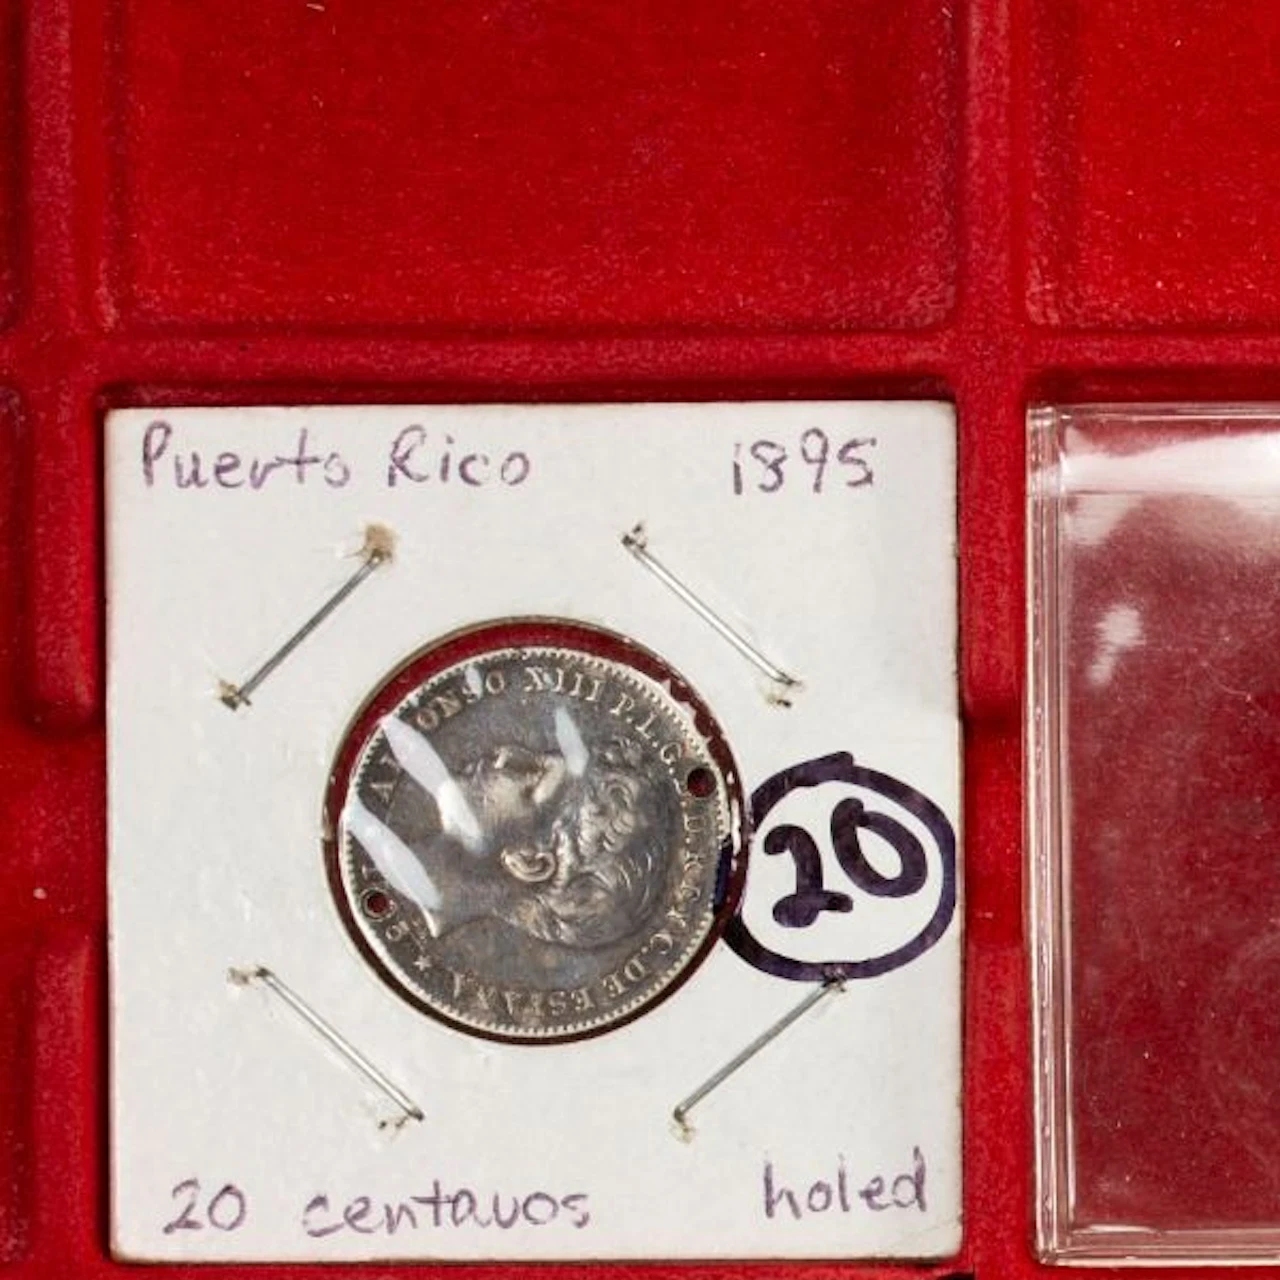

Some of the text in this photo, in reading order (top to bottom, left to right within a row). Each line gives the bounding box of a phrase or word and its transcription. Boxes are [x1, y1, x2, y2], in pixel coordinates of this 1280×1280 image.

[142, 421, 532, 490] Puerto Rico
[731, 428, 876, 494] 1895
[764, 798, 928, 928] 20
[167, 1179, 247, 1236] 20
[764, 1147, 928, 1220] holed
